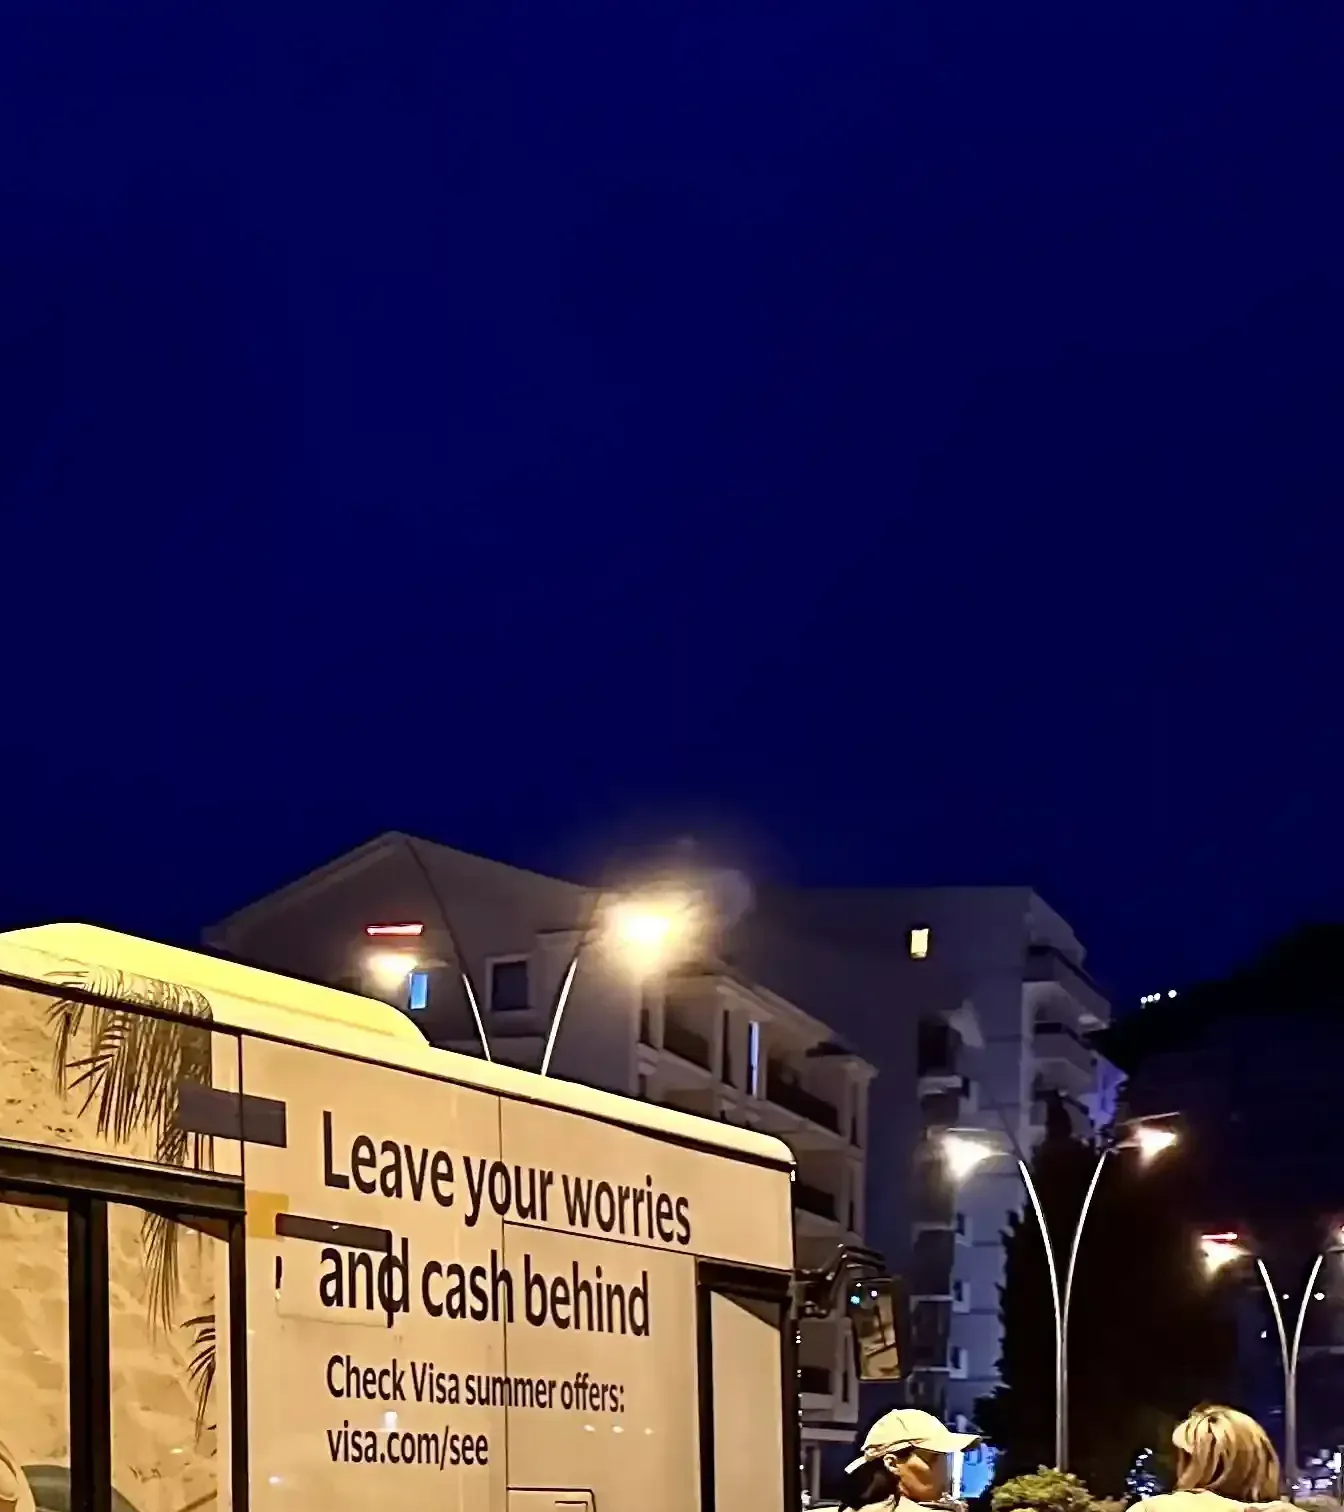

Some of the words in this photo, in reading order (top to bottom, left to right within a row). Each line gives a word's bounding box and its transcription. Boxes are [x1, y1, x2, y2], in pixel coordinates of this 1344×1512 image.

[322, 1110, 454, 1207] Leave
[463, 1155, 555, 1228] your
[562, 1175, 691, 1246] worries
[319, 1237, 410, 1314] and
[421, 1249, 514, 1323] cash
[524, 1253, 650, 1337] behind
[326, 1354, 405, 1402] Check
[411, 1361, 460, 1405] Visa
[465, 1374, 557, 1410] summer
[560, 1372, 625, 1414] offers:
[326, 1419, 490, 1471] visa.com/see
